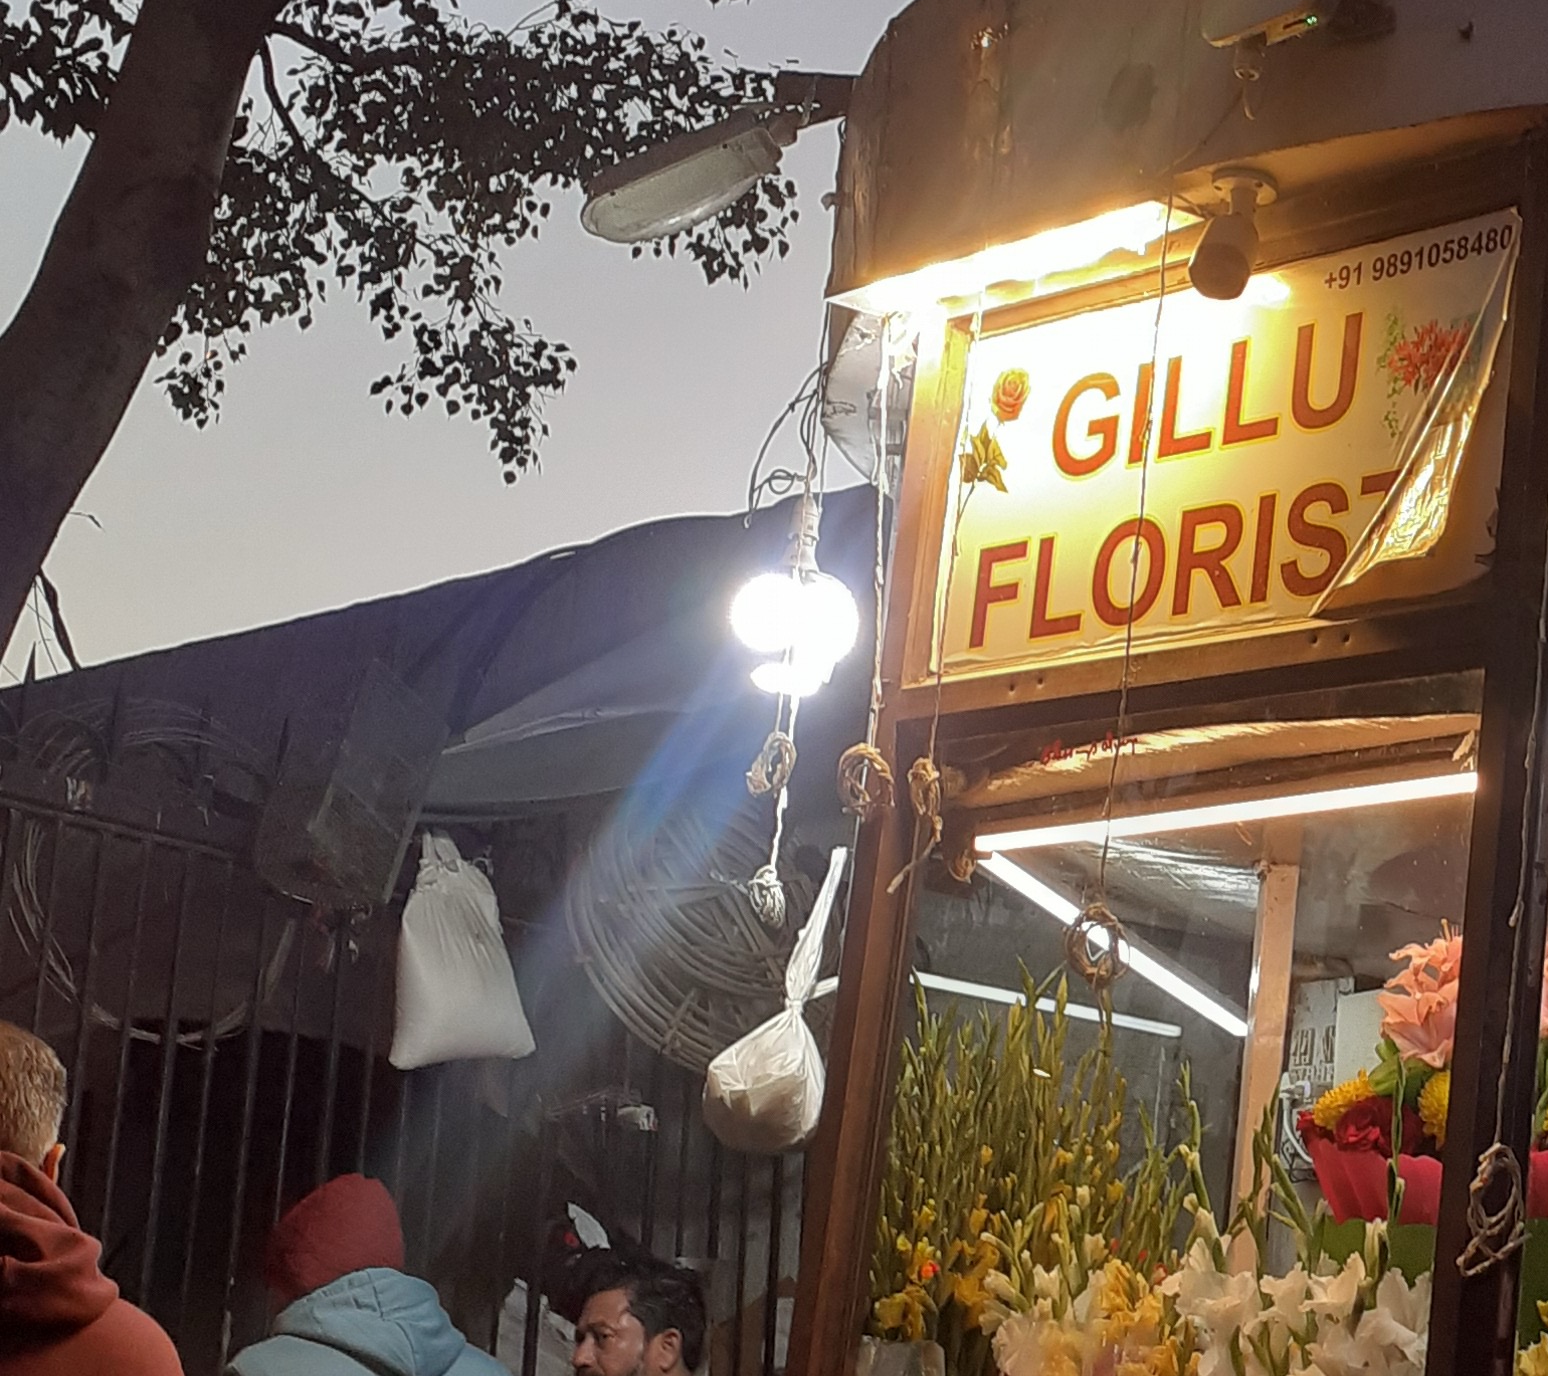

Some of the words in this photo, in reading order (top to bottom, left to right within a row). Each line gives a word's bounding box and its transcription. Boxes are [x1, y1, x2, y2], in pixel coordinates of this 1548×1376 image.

[1324, 261, 1363, 290] +91
[1371, 224, 1513, 282] 9891058480
[1051, 310, 1364, 480] GILLU
